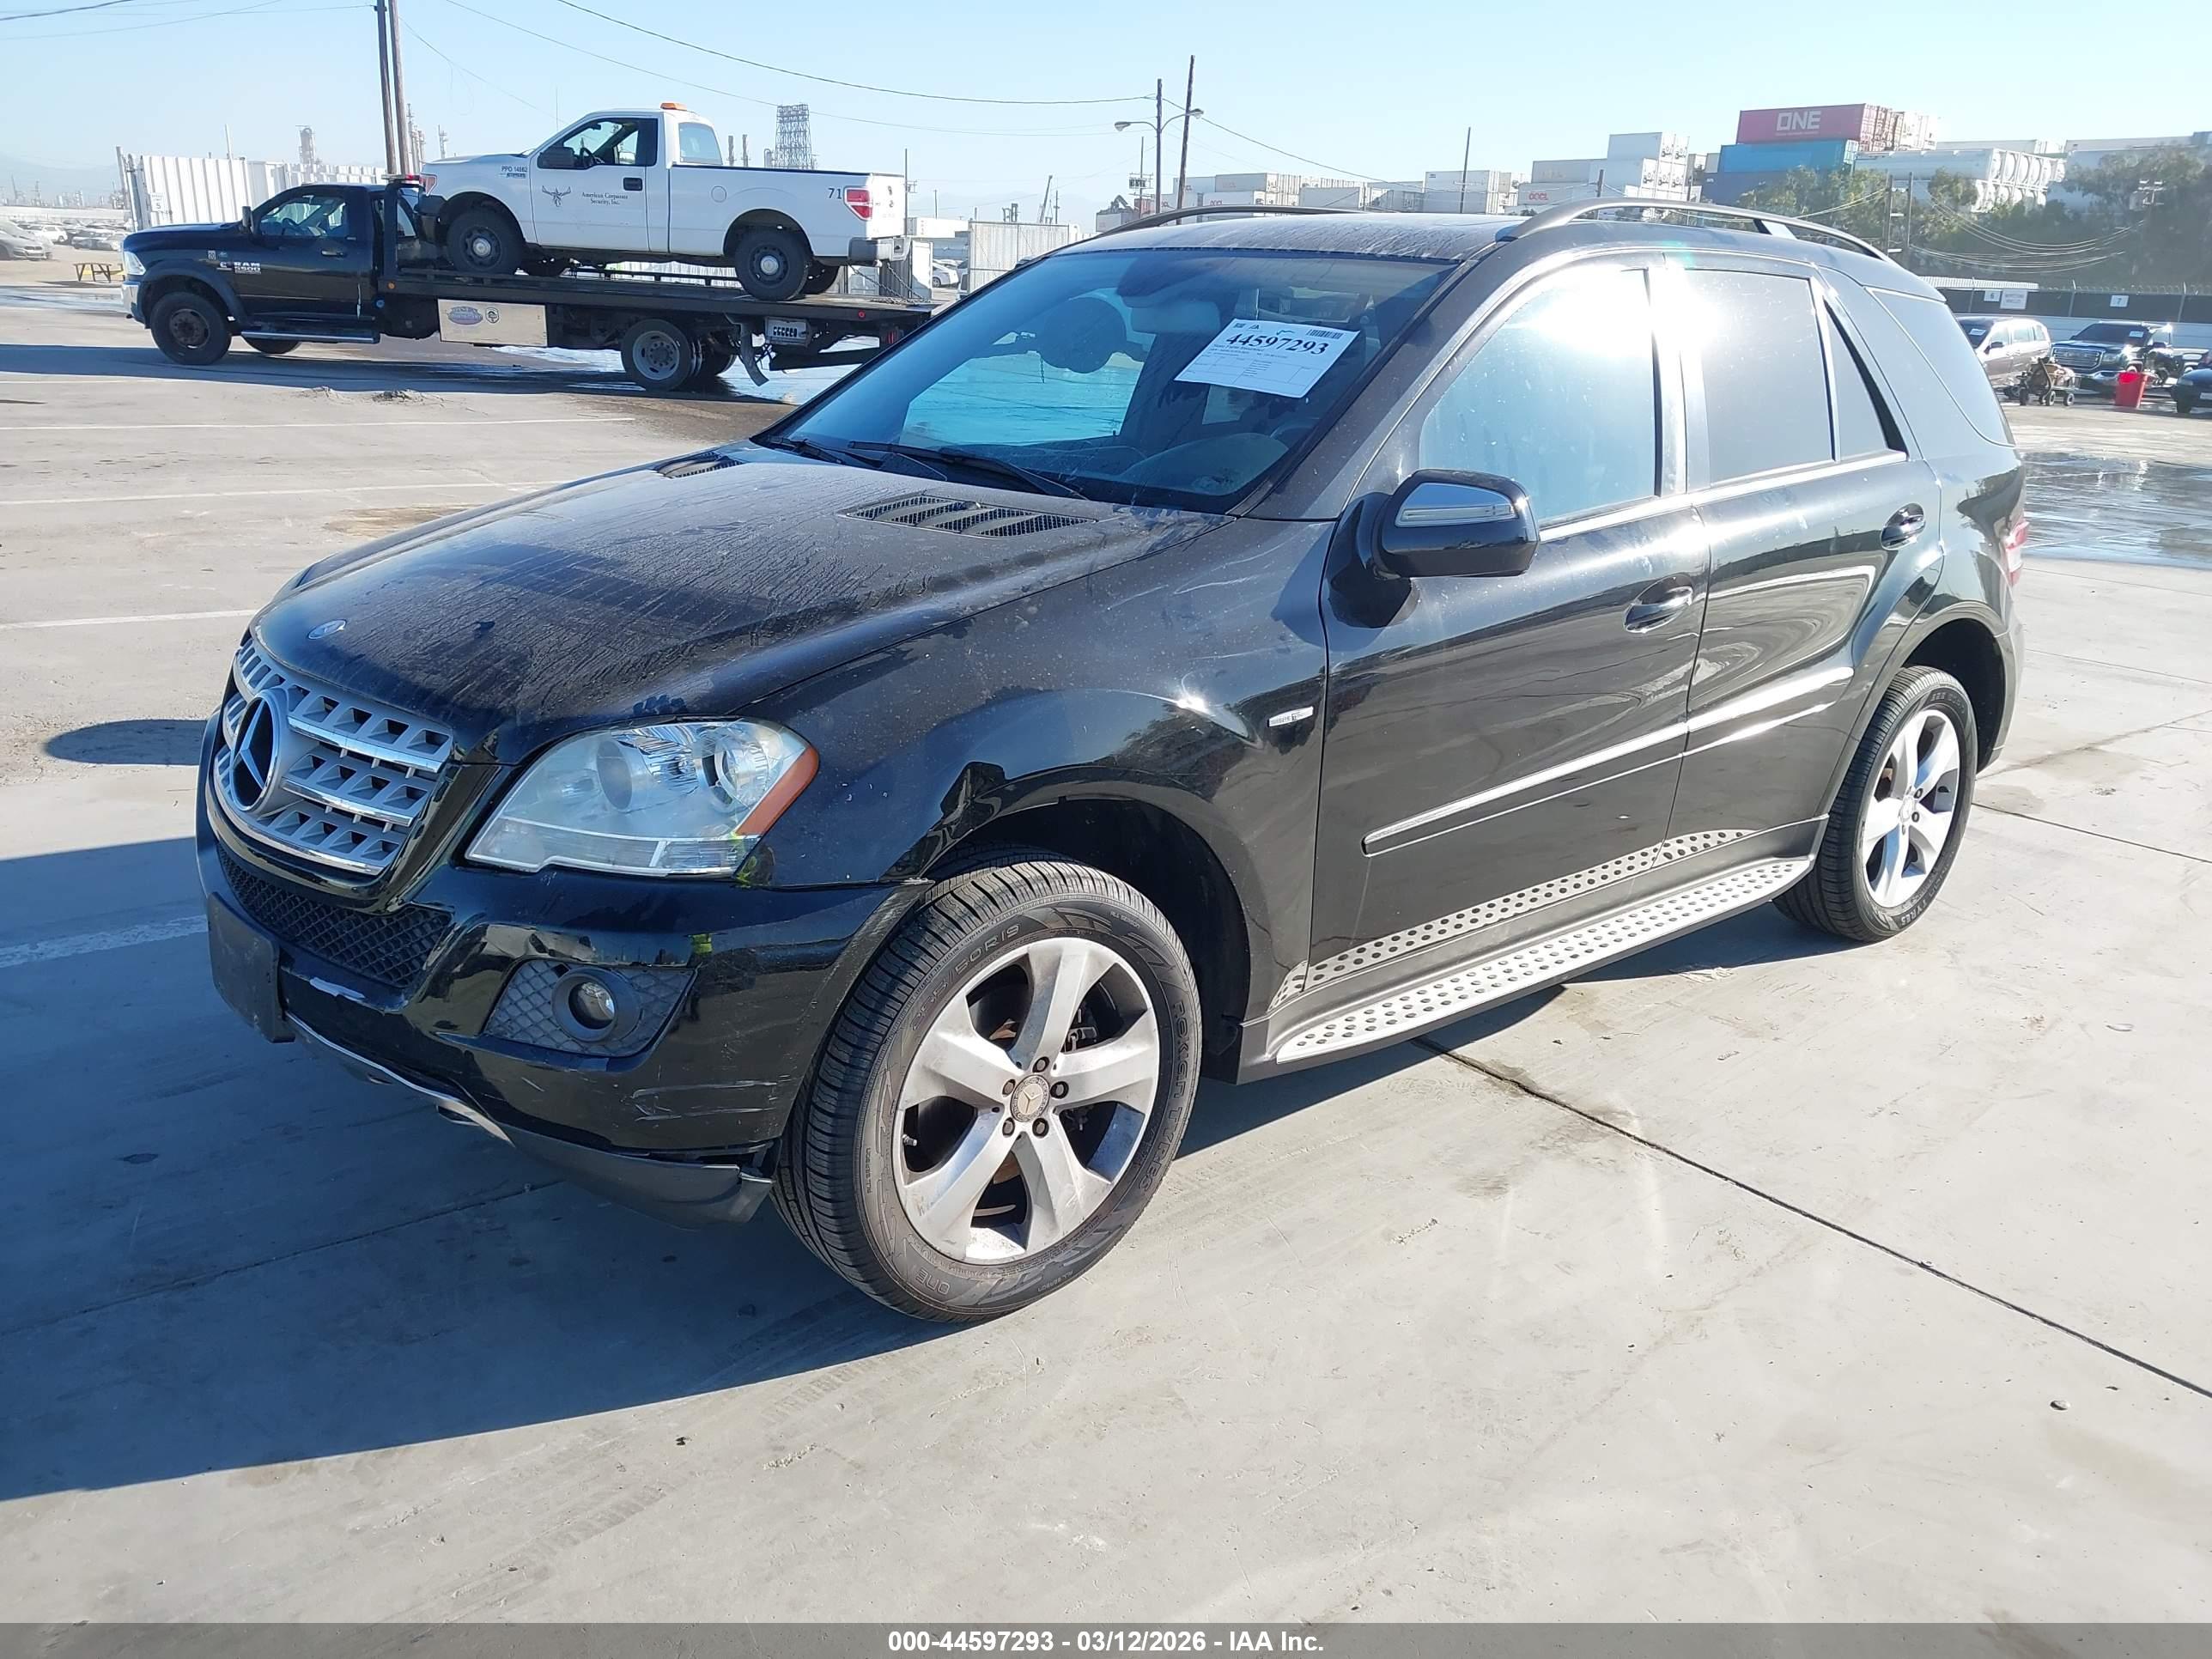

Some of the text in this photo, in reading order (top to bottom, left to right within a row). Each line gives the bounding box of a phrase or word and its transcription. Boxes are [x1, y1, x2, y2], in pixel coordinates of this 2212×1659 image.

[1776, 110, 1822, 131] ONE
[605, 192, 629, 201] Corporate
[828, 187, 842, 200] 71
[1225, 332, 1330, 356] 44597293
[1139, 1106, 1183, 1193] TYRES
